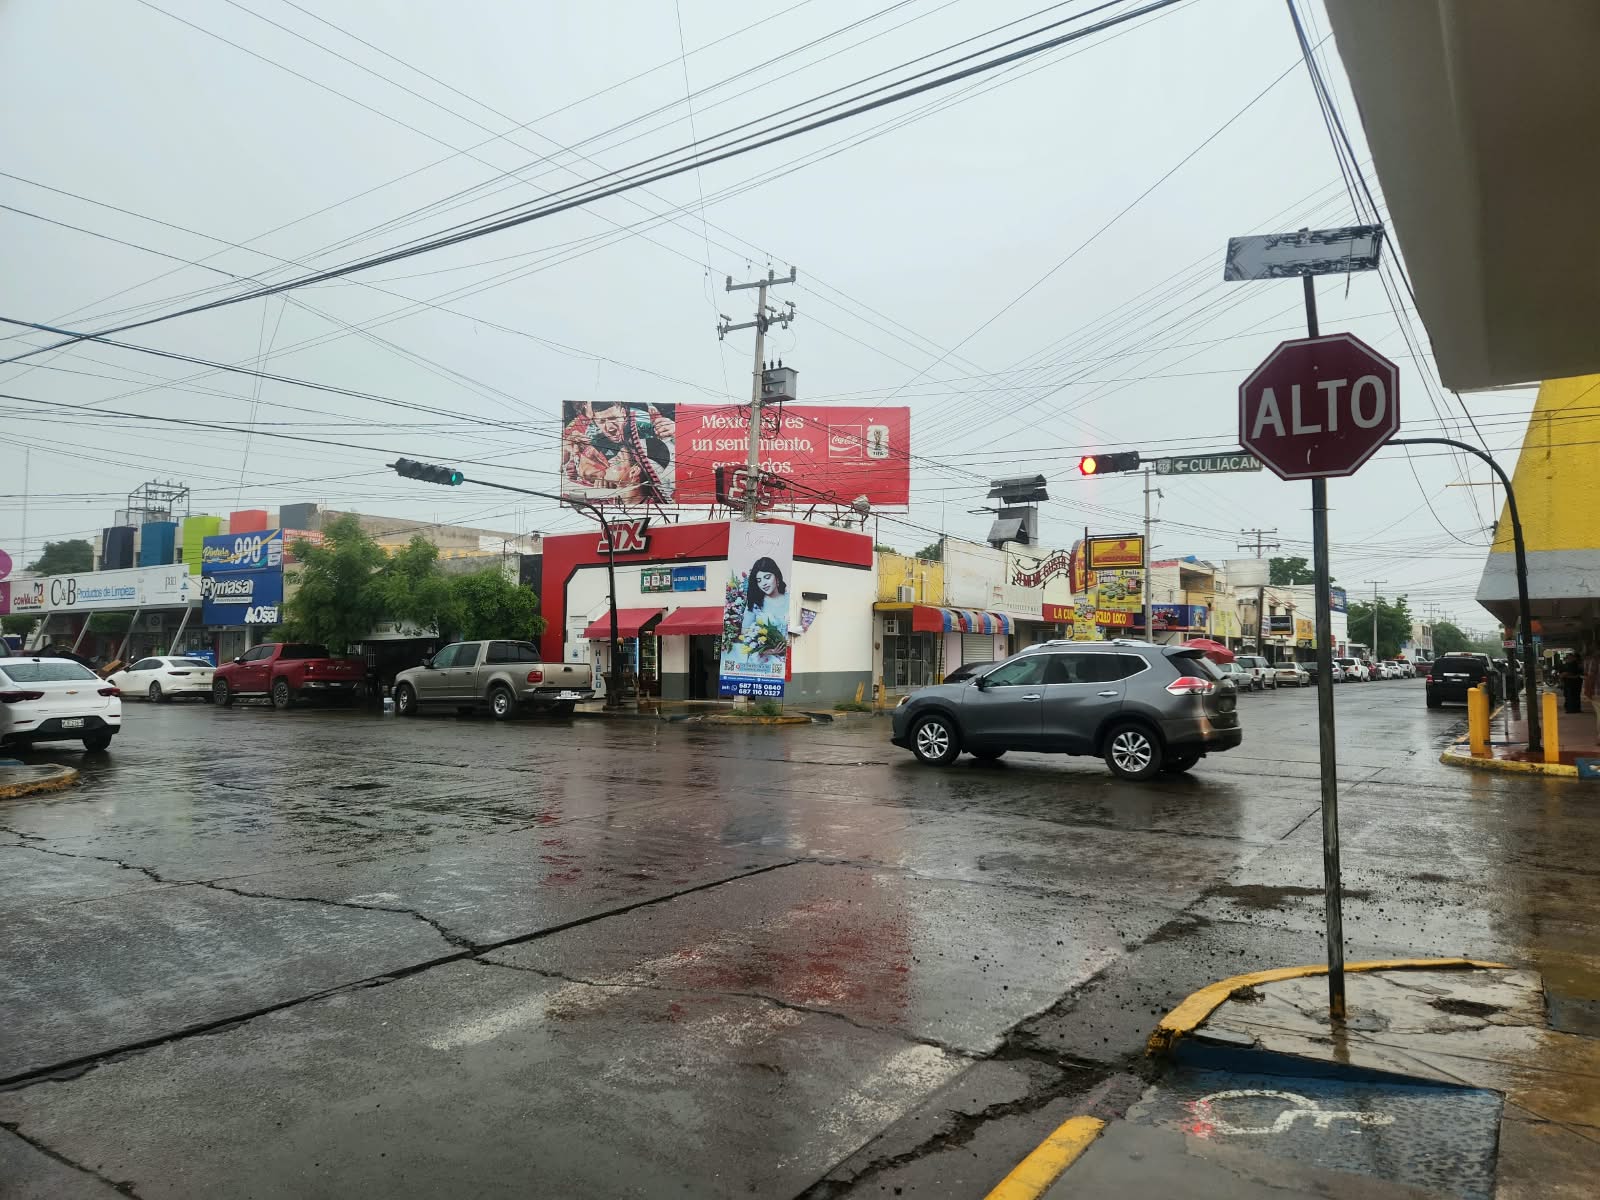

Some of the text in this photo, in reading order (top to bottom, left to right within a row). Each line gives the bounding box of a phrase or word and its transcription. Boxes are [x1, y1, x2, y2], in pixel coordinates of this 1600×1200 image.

[1251, 375, 1386, 439] ALTO
[785, 417, 804, 429] es
[692, 437, 814, 453] un sentmiento,
[1190, 457, 1260, 472] CULIACAN
[77, 585, 136, 599] Productos de Limpieza
[202, 577, 253, 600] Pymasa
[1053, 608, 1063, 619] LA
[1113, 612, 1127, 624] LOCO
